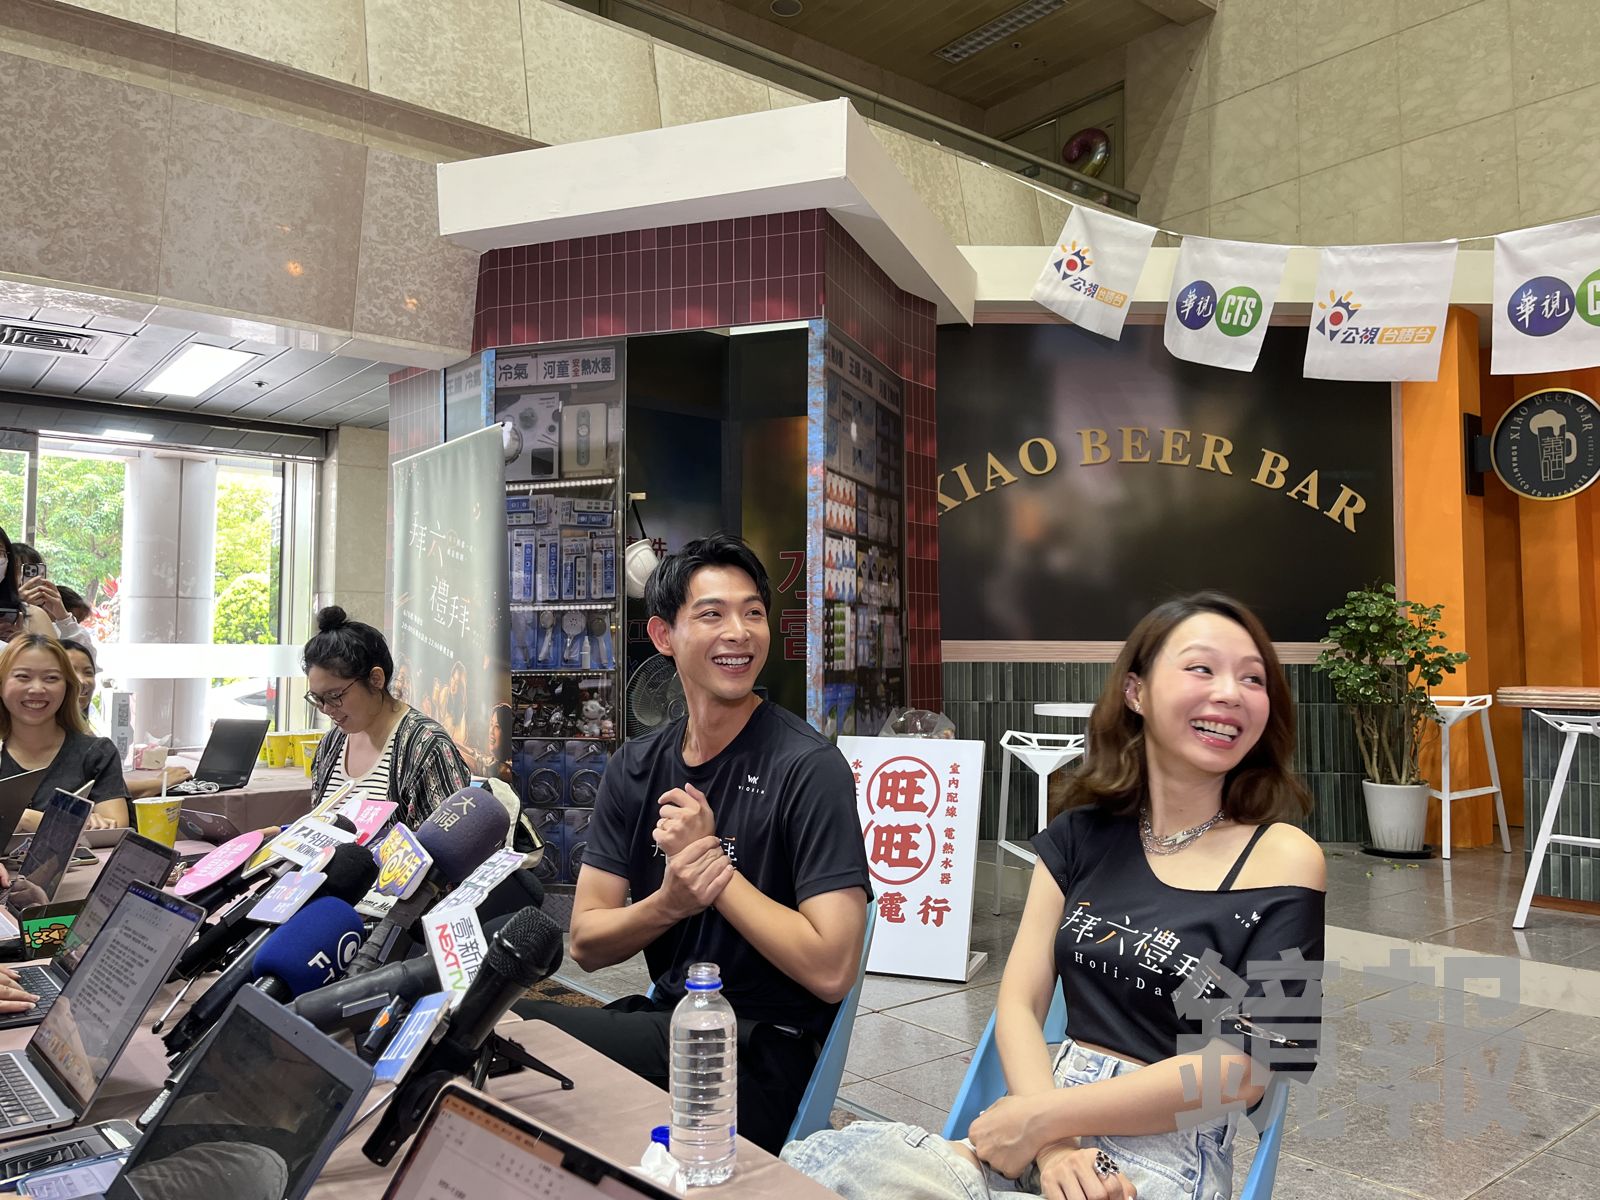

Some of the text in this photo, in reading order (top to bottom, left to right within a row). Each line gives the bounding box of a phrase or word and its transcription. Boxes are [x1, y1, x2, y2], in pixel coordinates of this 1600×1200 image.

[1069, 276, 1101, 299] 公視
[1179, 288, 1214, 321] 華視
[1220, 294, 1256, 327] CTS
[1515, 288, 1571, 329] 華視
[1340, 326, 1432, 345] 公視 台語台
[498, 362, 529, 382] 冷氣
[1510, 392, 1594, 440] XIAO BEER BAR
[1075, 426, 1235, 476] BEER
[1250, 447, 1367, 534] BAR
[939, 763, 961, 885] 室內配線 電熱水器
[1060, 901, 1220, 1004] 拜六禮拜
[1074, 951, 1183, 1003] Holi-Day
